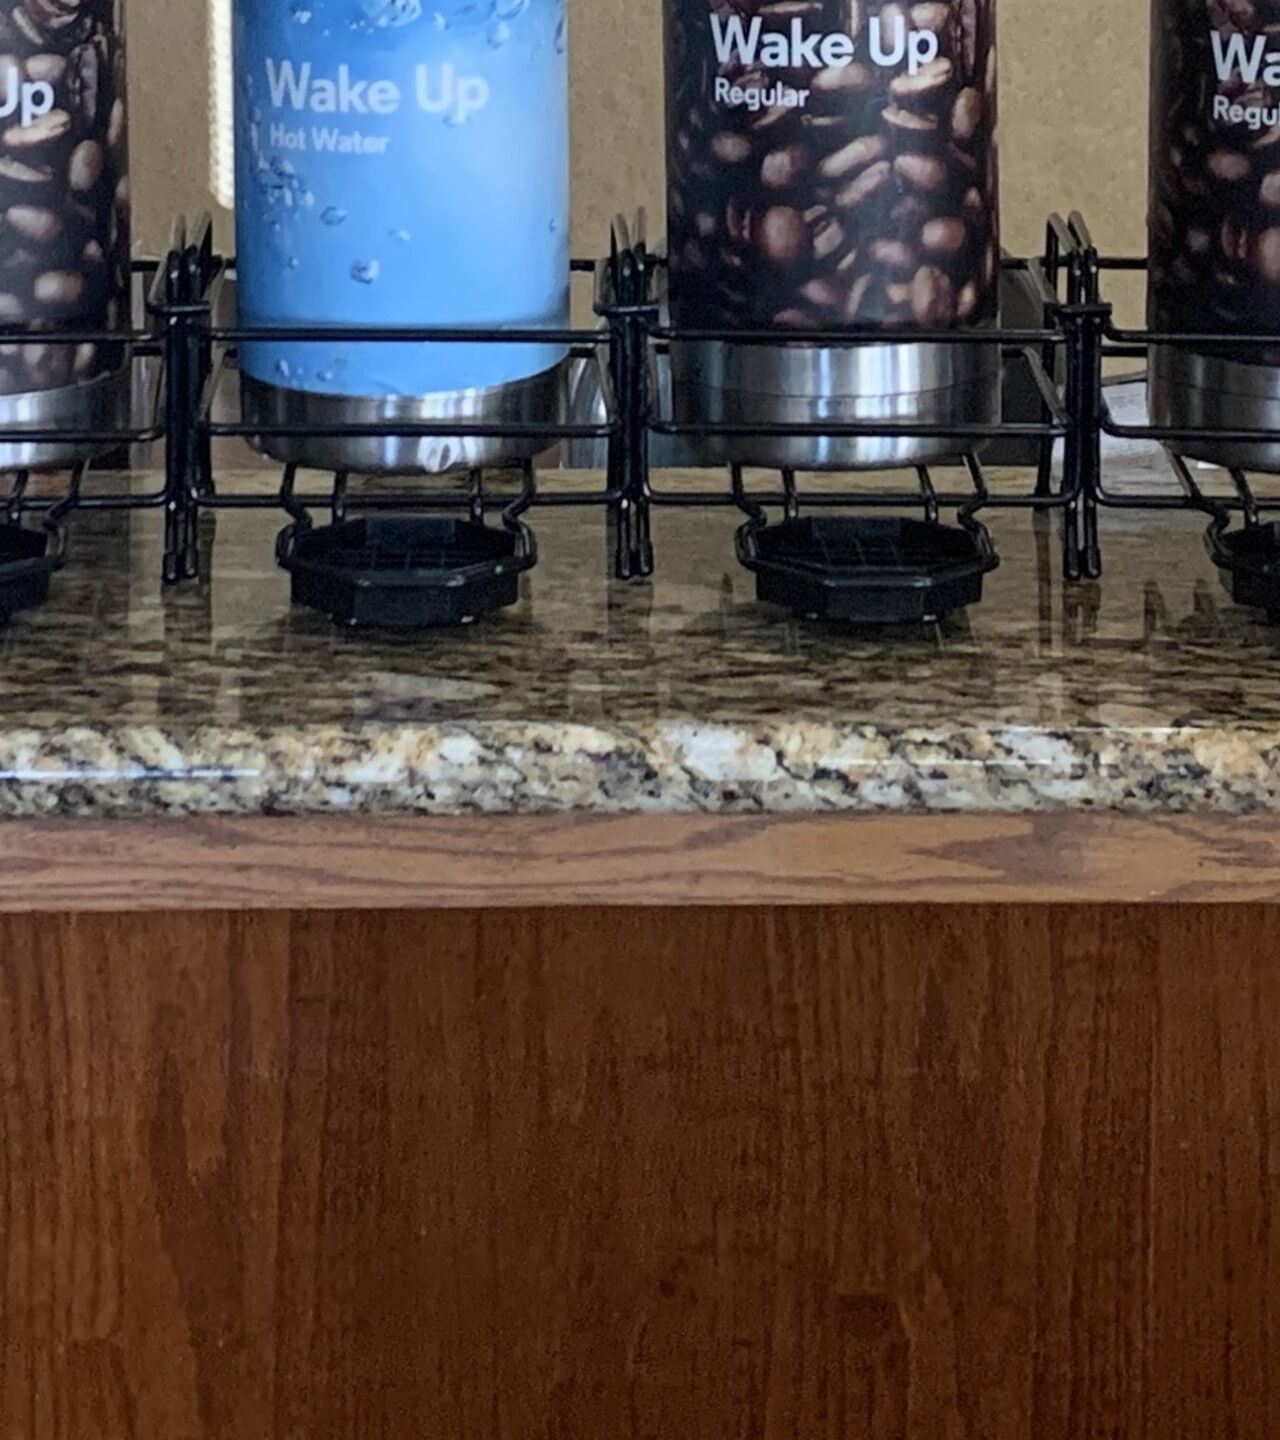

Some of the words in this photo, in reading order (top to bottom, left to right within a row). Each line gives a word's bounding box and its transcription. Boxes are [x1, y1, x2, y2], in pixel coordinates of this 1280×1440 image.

[710, 13, 855, 69] Wake
[869, 14, 938, 76] Up
[266, 57, 401, 113] Wake
[415, 62, 490, 124] Up
[714, 76, 811, 111] Regular
[270, 122, 306, 150] Hot
[312, 127, 391, 154] Water
